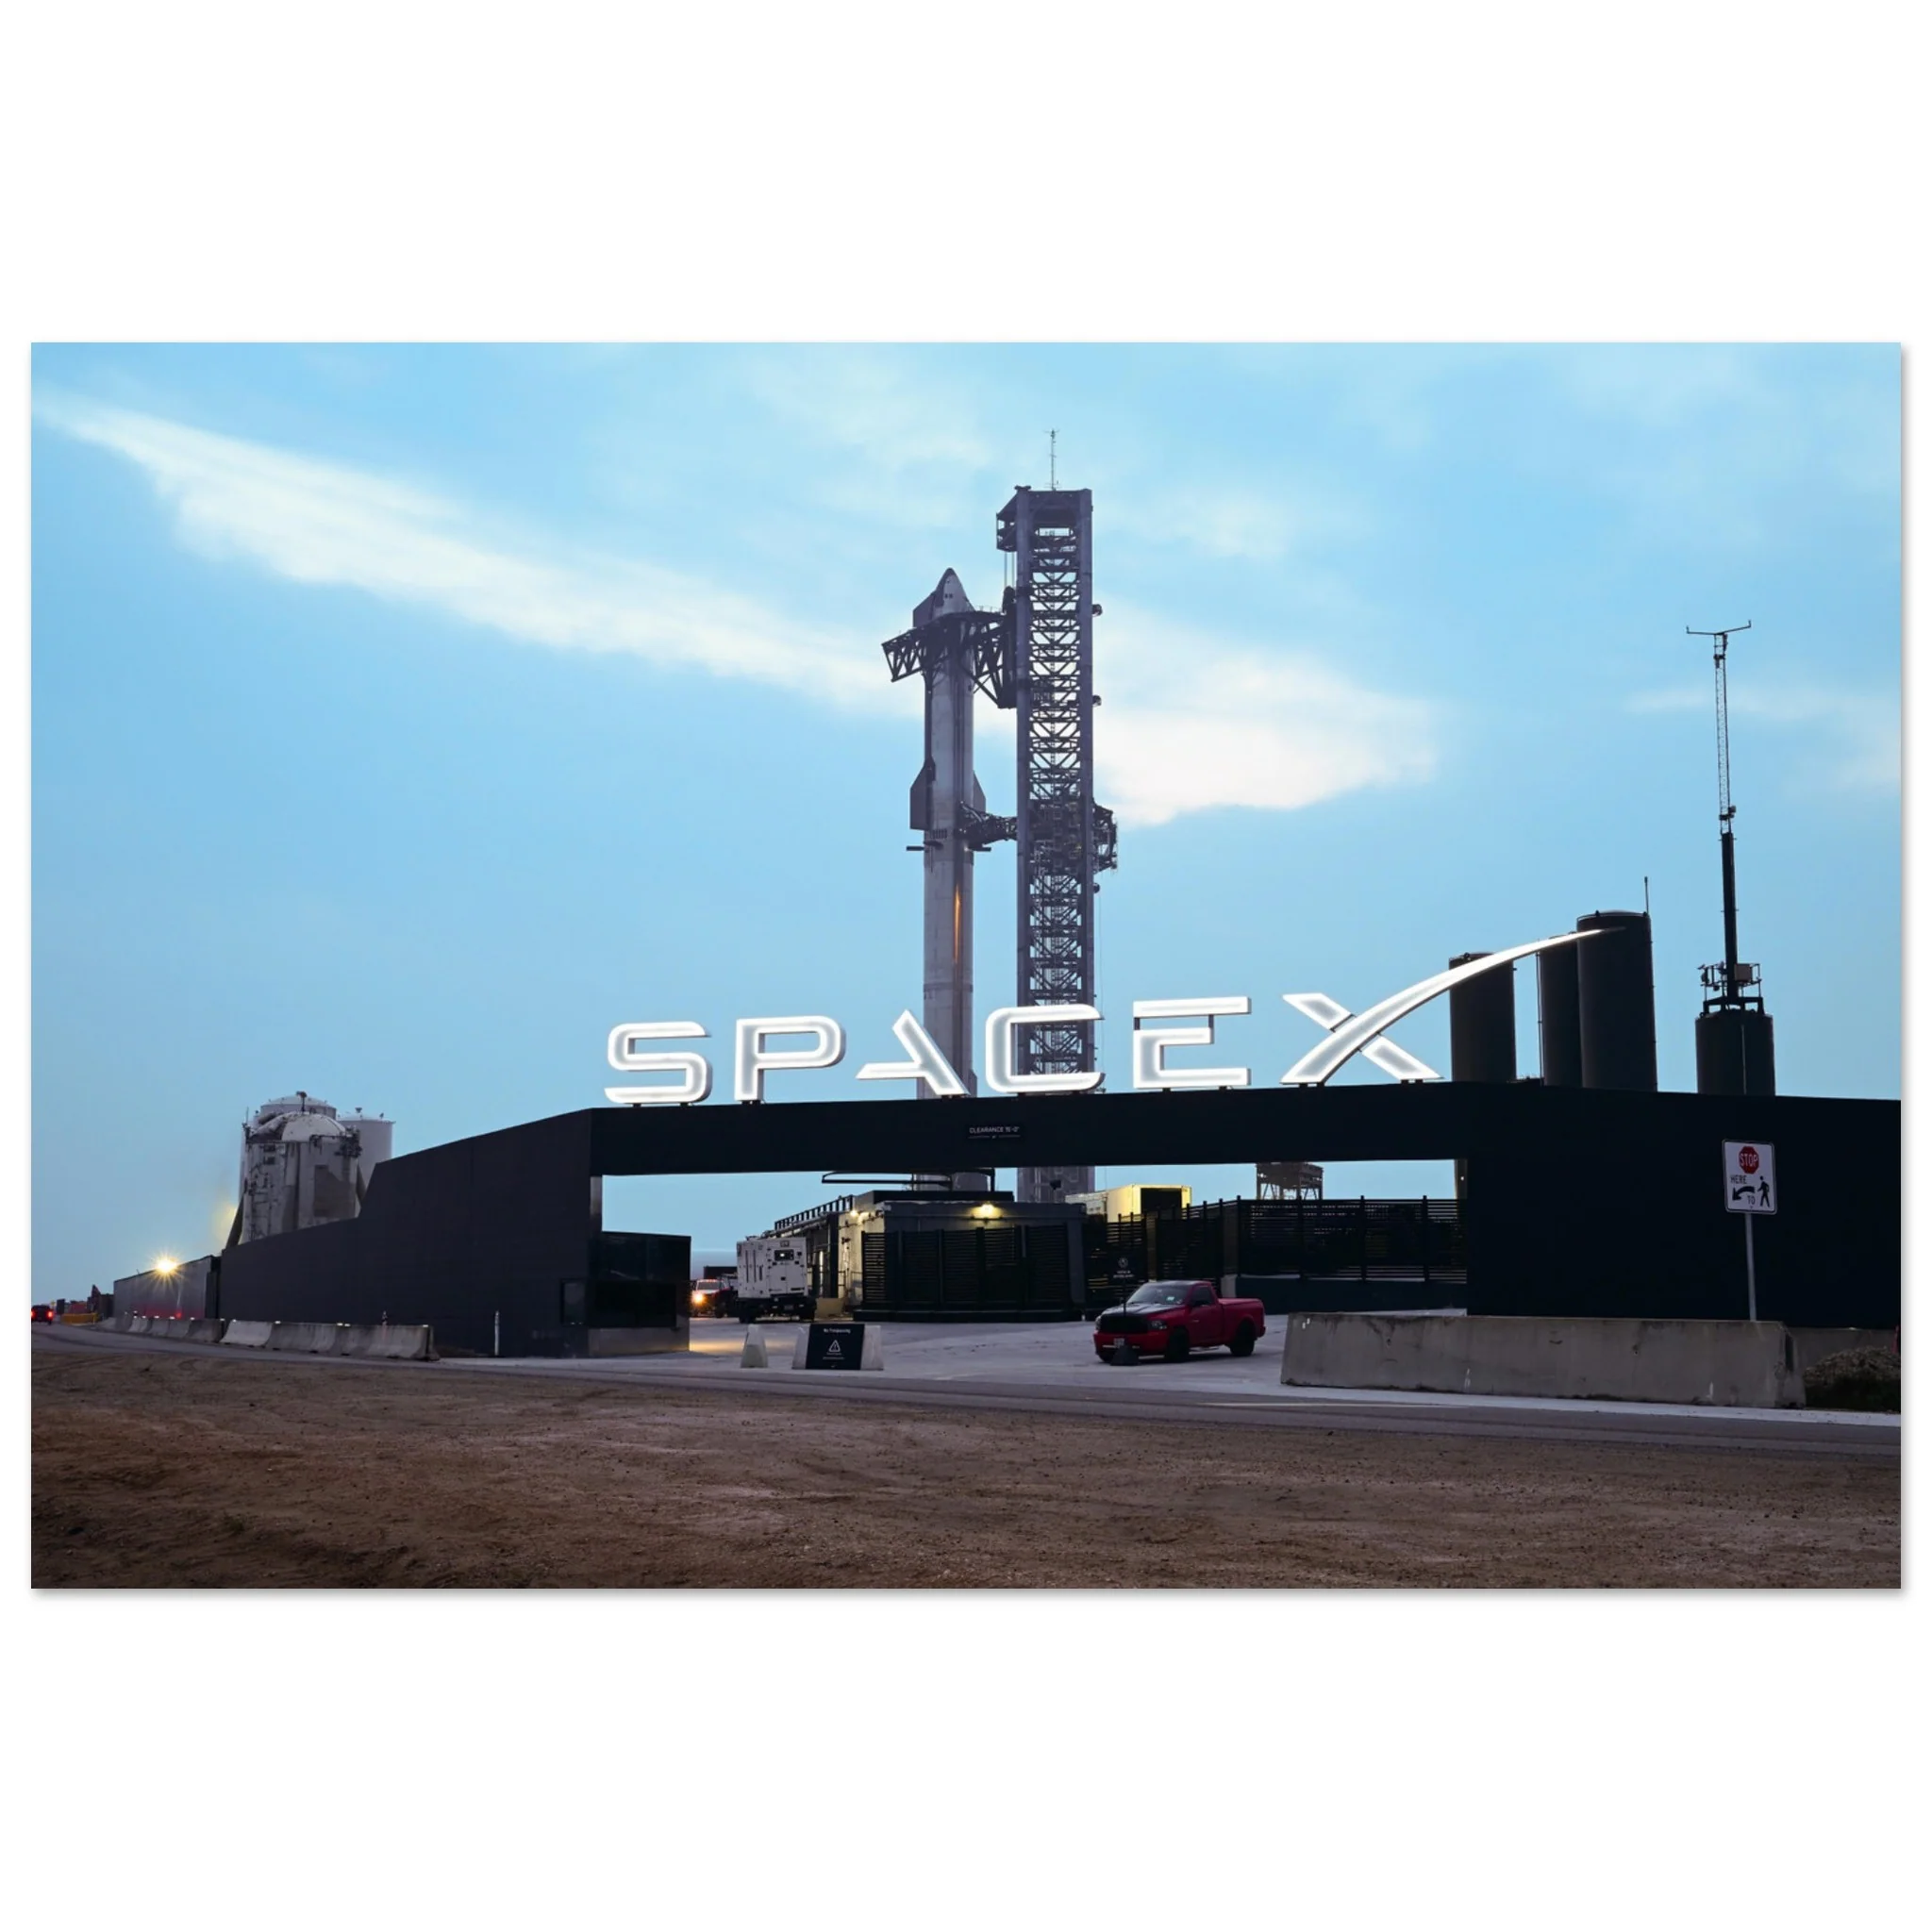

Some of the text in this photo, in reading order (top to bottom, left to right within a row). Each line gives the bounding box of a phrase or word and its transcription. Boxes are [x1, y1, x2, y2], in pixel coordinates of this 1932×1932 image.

[604, 927, 1615, 1106] SPACEX
[969, 1125, 1005, 1134] CLEARANCE
[1740, 1153, 1758, 1168] STOP
[1730, 1174, 1747, 1185] HERE
[1747, 1194, 1756, 1206] TO
